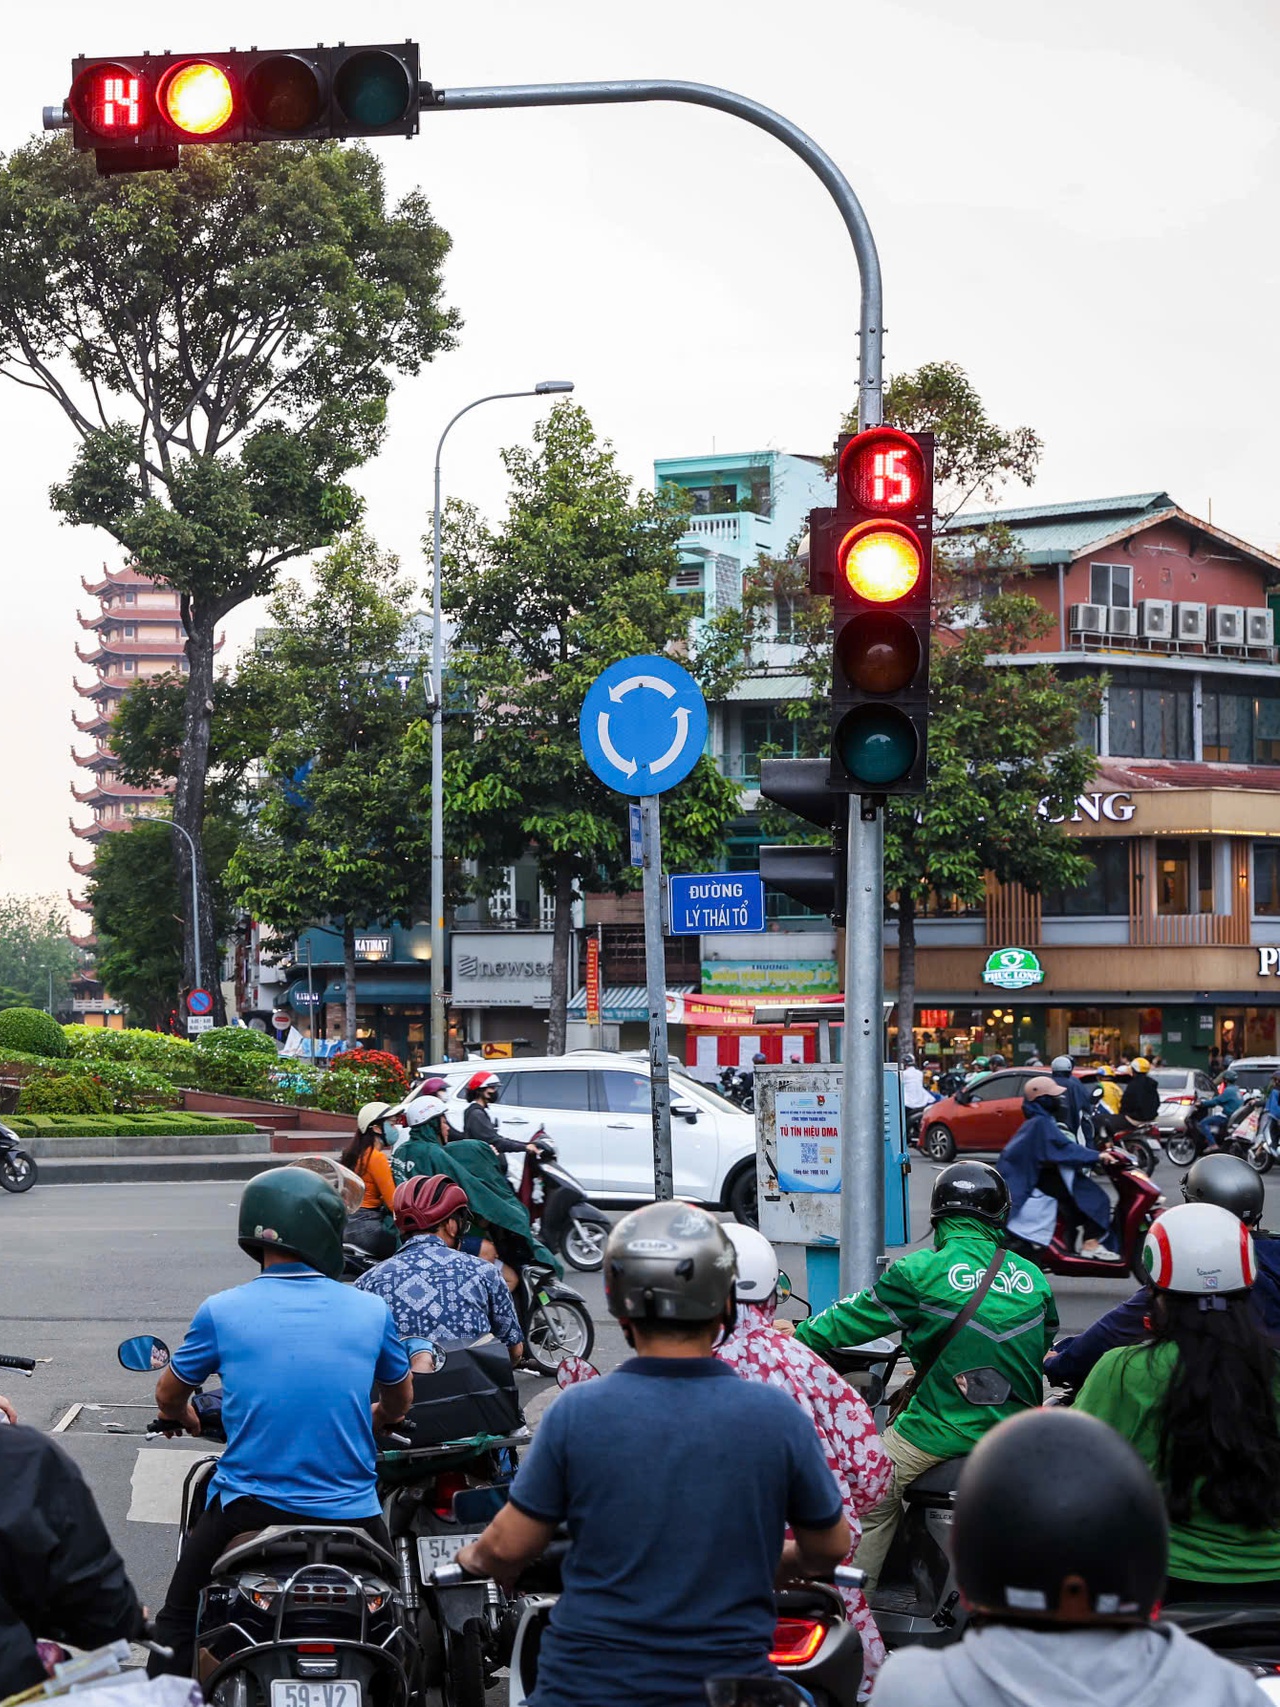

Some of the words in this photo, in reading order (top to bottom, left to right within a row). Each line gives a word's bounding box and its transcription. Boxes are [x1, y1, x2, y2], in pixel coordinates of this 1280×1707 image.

[104, 79, 139, 125] 14
[874, 450, 911, 503] 15
[689, 881, 743, 899] ĐƯỜNG
[686, 904, 701, 928] LÝ
[703, 904, 730, 927] THÁI
[732, 900, 749, 926] TỔ
[355, 939, 388, 952] KATINAT
[1014, 971, 1041, 981] LONG
[780, 1124, 789, 1137] TỦ
[804, 1125, 820, 1139] HIỆU
[822, 1127, 838, 1137] DMA
[947, 1262, 1035, 1294] Grab
